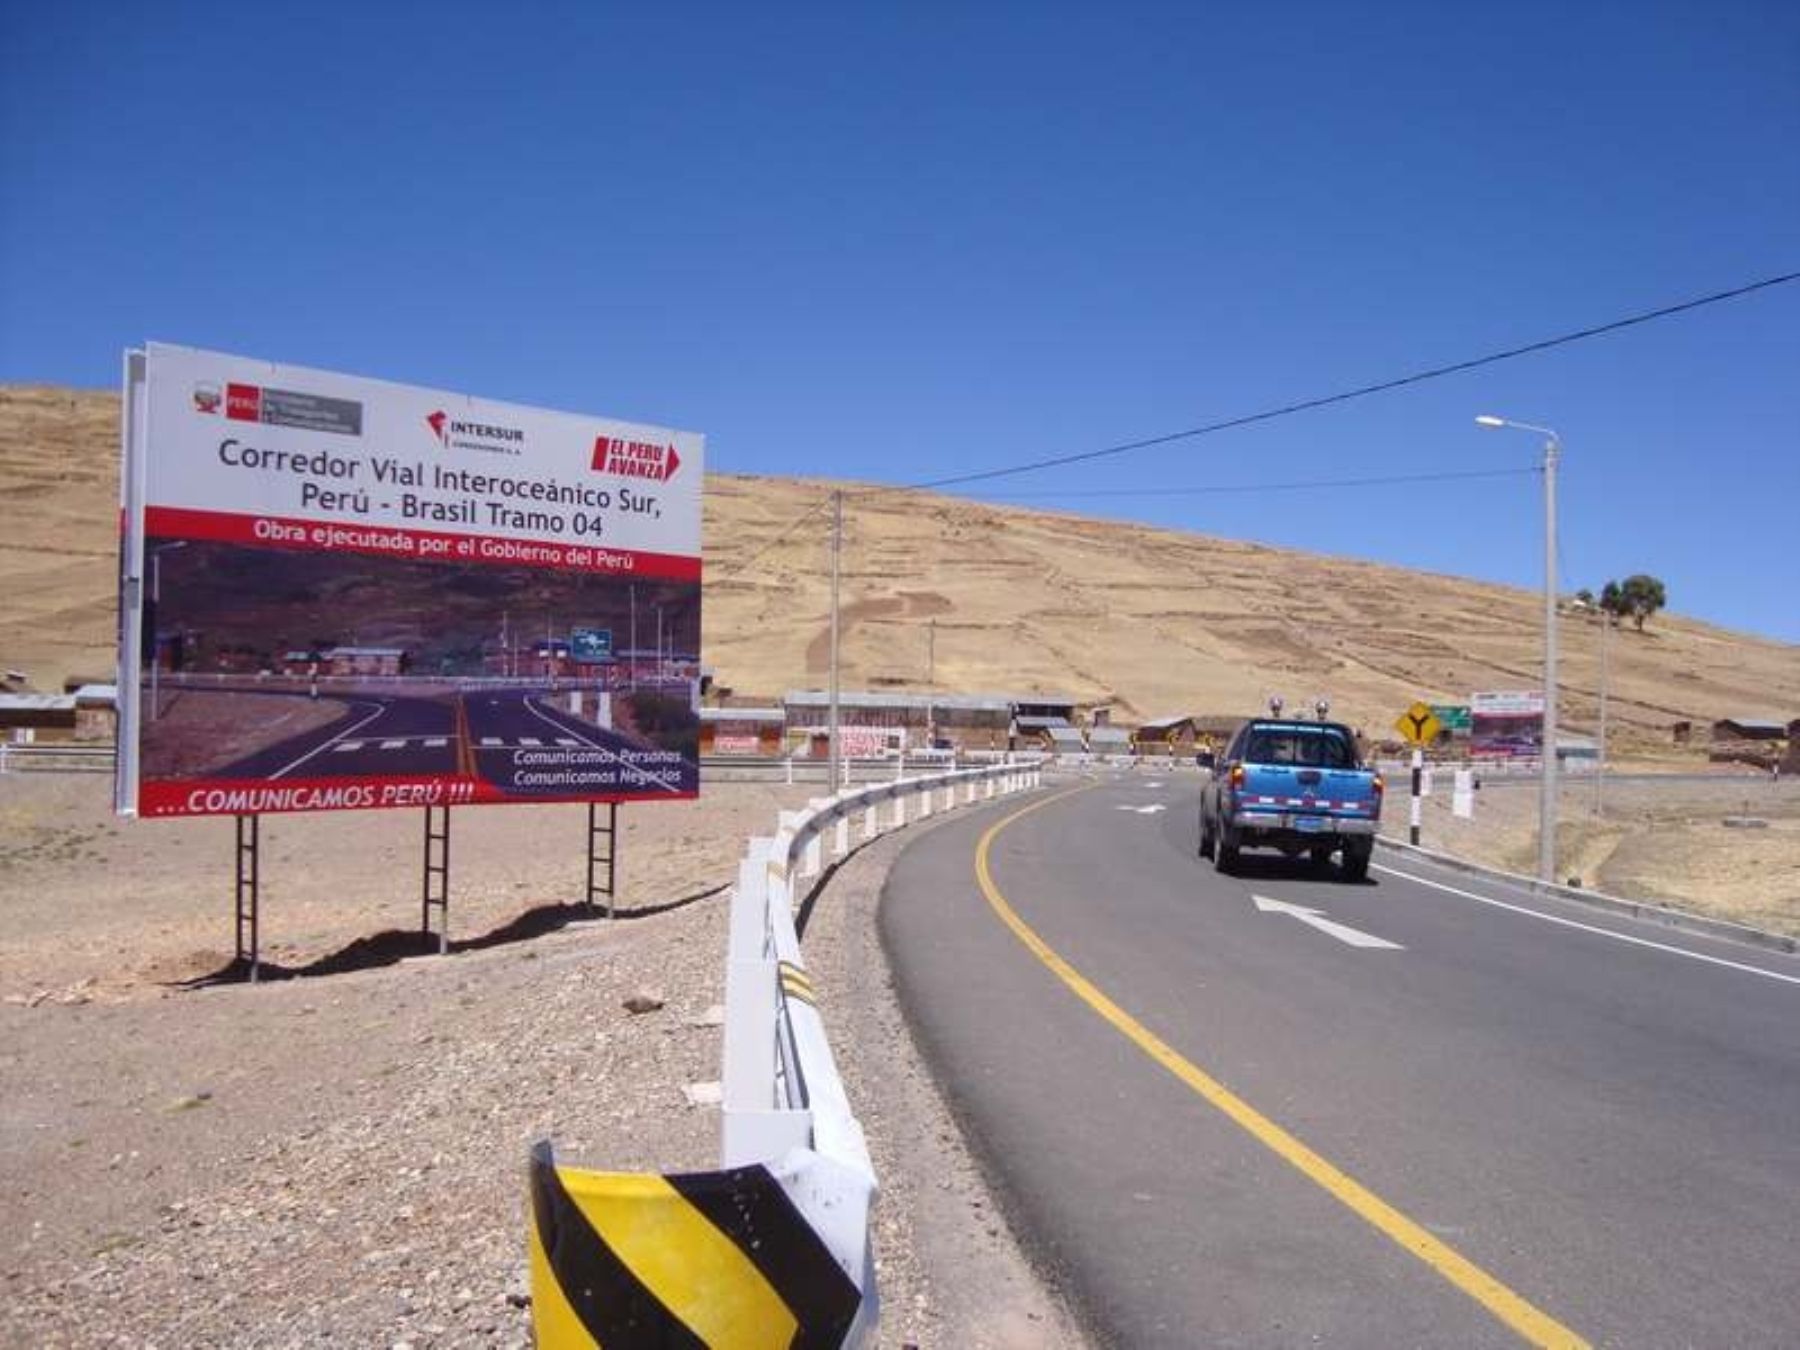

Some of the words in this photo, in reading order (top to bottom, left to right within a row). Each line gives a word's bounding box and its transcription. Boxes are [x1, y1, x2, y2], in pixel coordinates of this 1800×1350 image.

[451, 421, 523, 441] INTERSUR
[611, 438, 624, 456] EL
[219, 440, 360, 478] Corredor
[371, 457, 423, 486] Vial
[434, 463, 610, 507] Interoceánico
[619, 489, 661, 518] Sur,
[608, 458, 664, 479] AVANZA
[301, 483, 369, 513] Perú
[402, 494, 476, 523] Brasil
[486, 502, 564, 534] Tramo
[573, 512, 602, 536] 04
[254, 520, 306, 541] Obra
[312, 526, 414, 550] ejecutada
[419, 539, 450, 555] por
[458, 539, 475, 555] el
[481, 540, 561, 564] Gobierno
[566, 548, 592, 565] del
[597, 552, 633, 569] Perú
[514, 750, 616, 765] Comunicamos
[620, 750, 682, 763] Personas
[514, 769, 616, 785] Comunicamos
[380, 778, 442, 804] PERÚ
